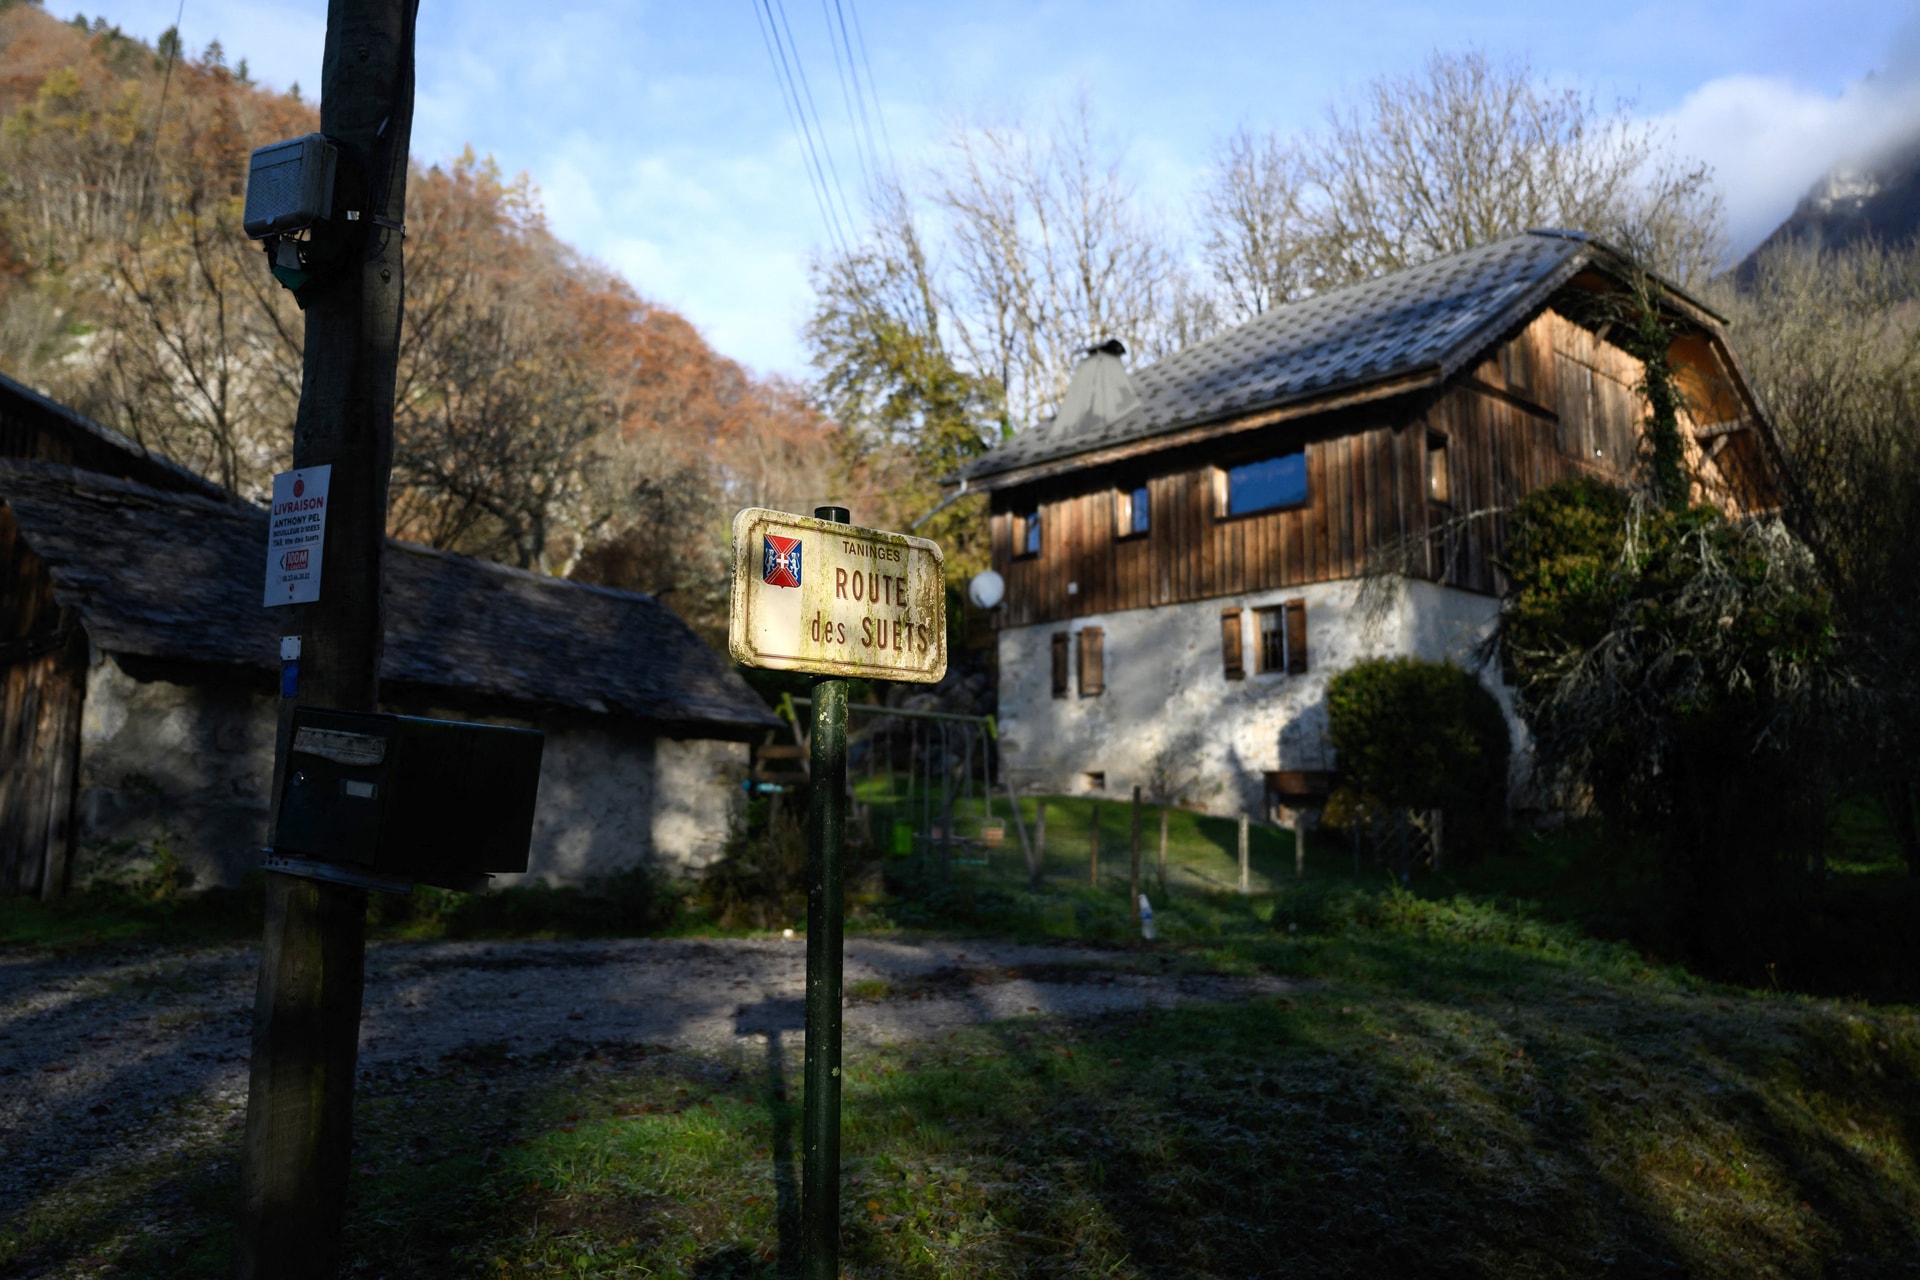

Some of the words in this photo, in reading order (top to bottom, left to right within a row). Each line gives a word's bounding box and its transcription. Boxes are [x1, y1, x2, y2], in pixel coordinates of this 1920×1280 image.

[274, 496, 324, 516] LIVRAISON
[274, 515, 307, 528] ANTHONY
[308, 513, 320, 523] PEL
[842, 541, 901, 563] TANINGES
[835, 567, 908, 608] ROUTE
[811, 610, 845, 645] des
[861, 616, 929, 653] SUETS
